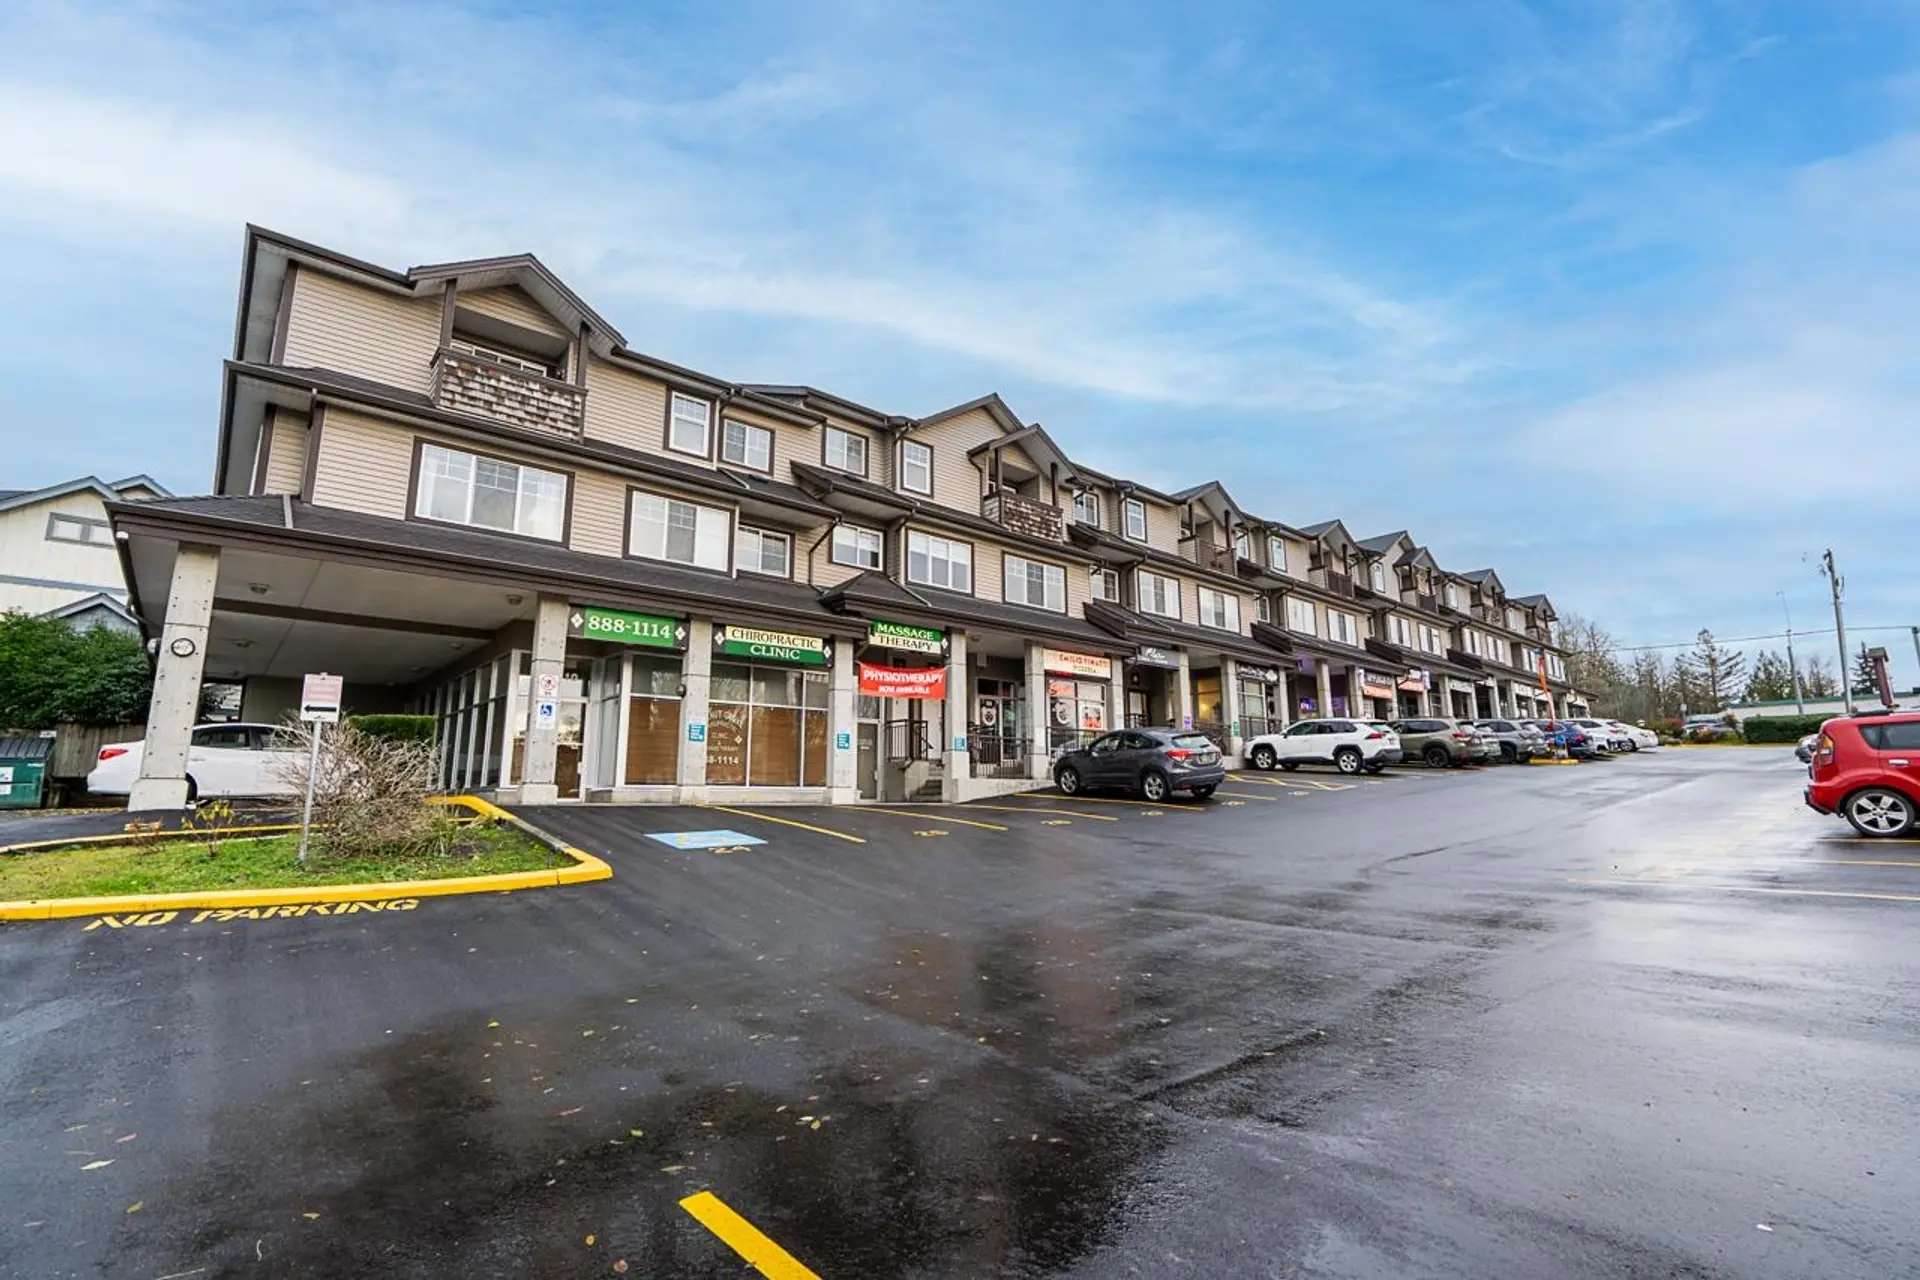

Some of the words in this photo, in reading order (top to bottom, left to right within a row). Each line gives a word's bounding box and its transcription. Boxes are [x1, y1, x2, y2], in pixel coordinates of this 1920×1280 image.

[587, 615, 672, 639] 888-1114
[877, 623, 934, 640] MASSAGE
[730, 628, 818, 649] CHIROPRACTIC
[879, 635, 933, 651] THERAPY
[750, 645, 801, 660] CLINIC
[863, 669, 944, 684] PHYSIOTHERAPY
[83, 911, 179, 932] NO
[190, 899, 420, 924] PARKING
